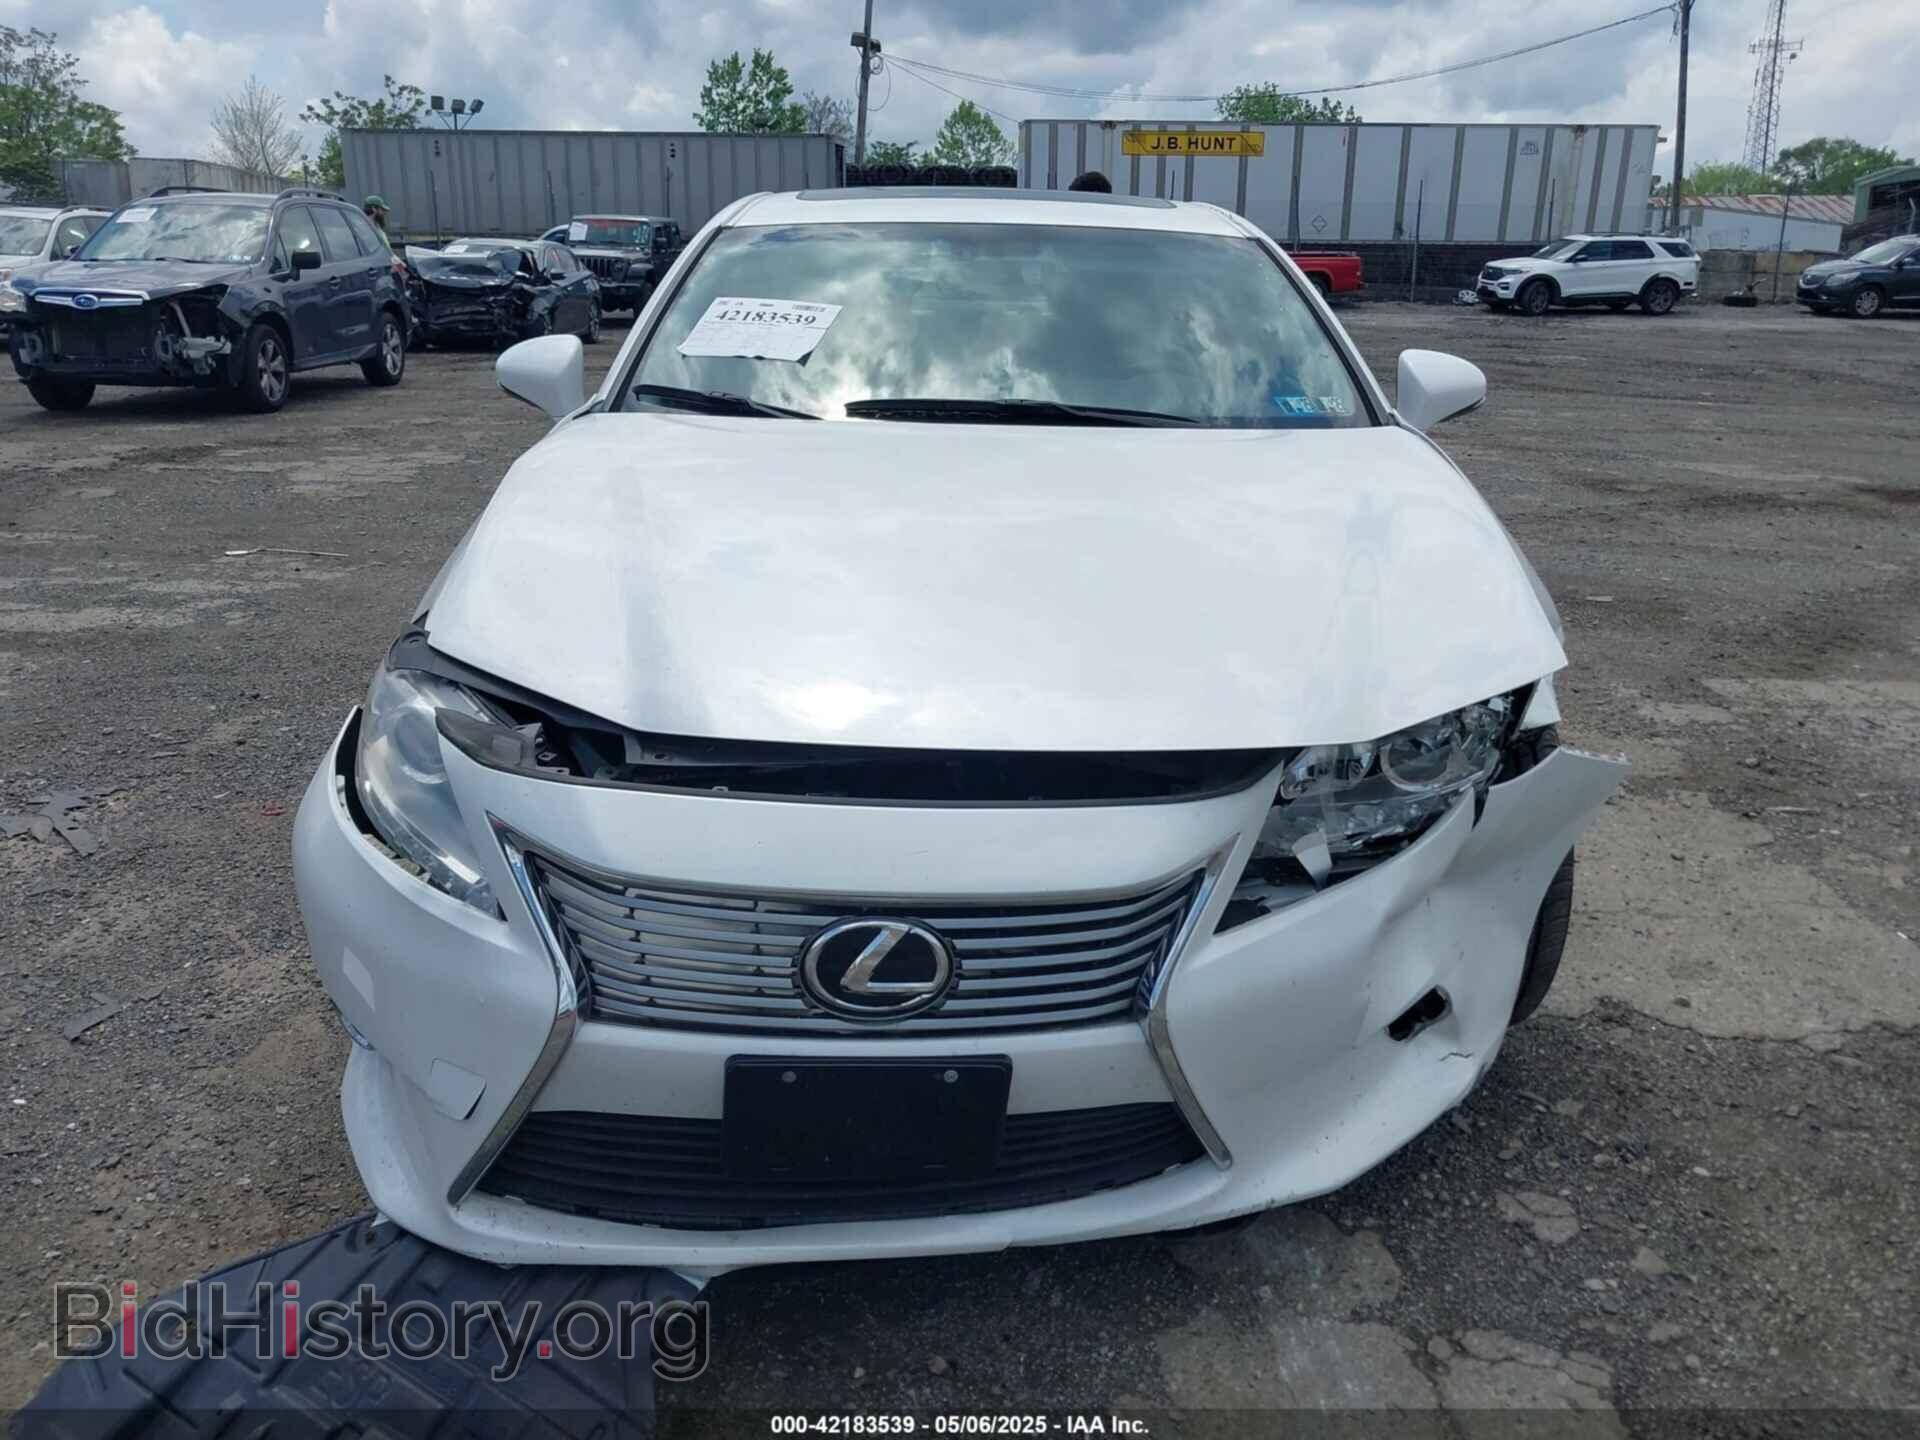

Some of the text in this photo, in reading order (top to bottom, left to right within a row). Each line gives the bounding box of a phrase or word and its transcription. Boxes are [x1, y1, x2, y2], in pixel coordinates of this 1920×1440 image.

[1151, 136, 1236, 150] J.B. HUNT
[715, 309, 817, 325] 42183539
